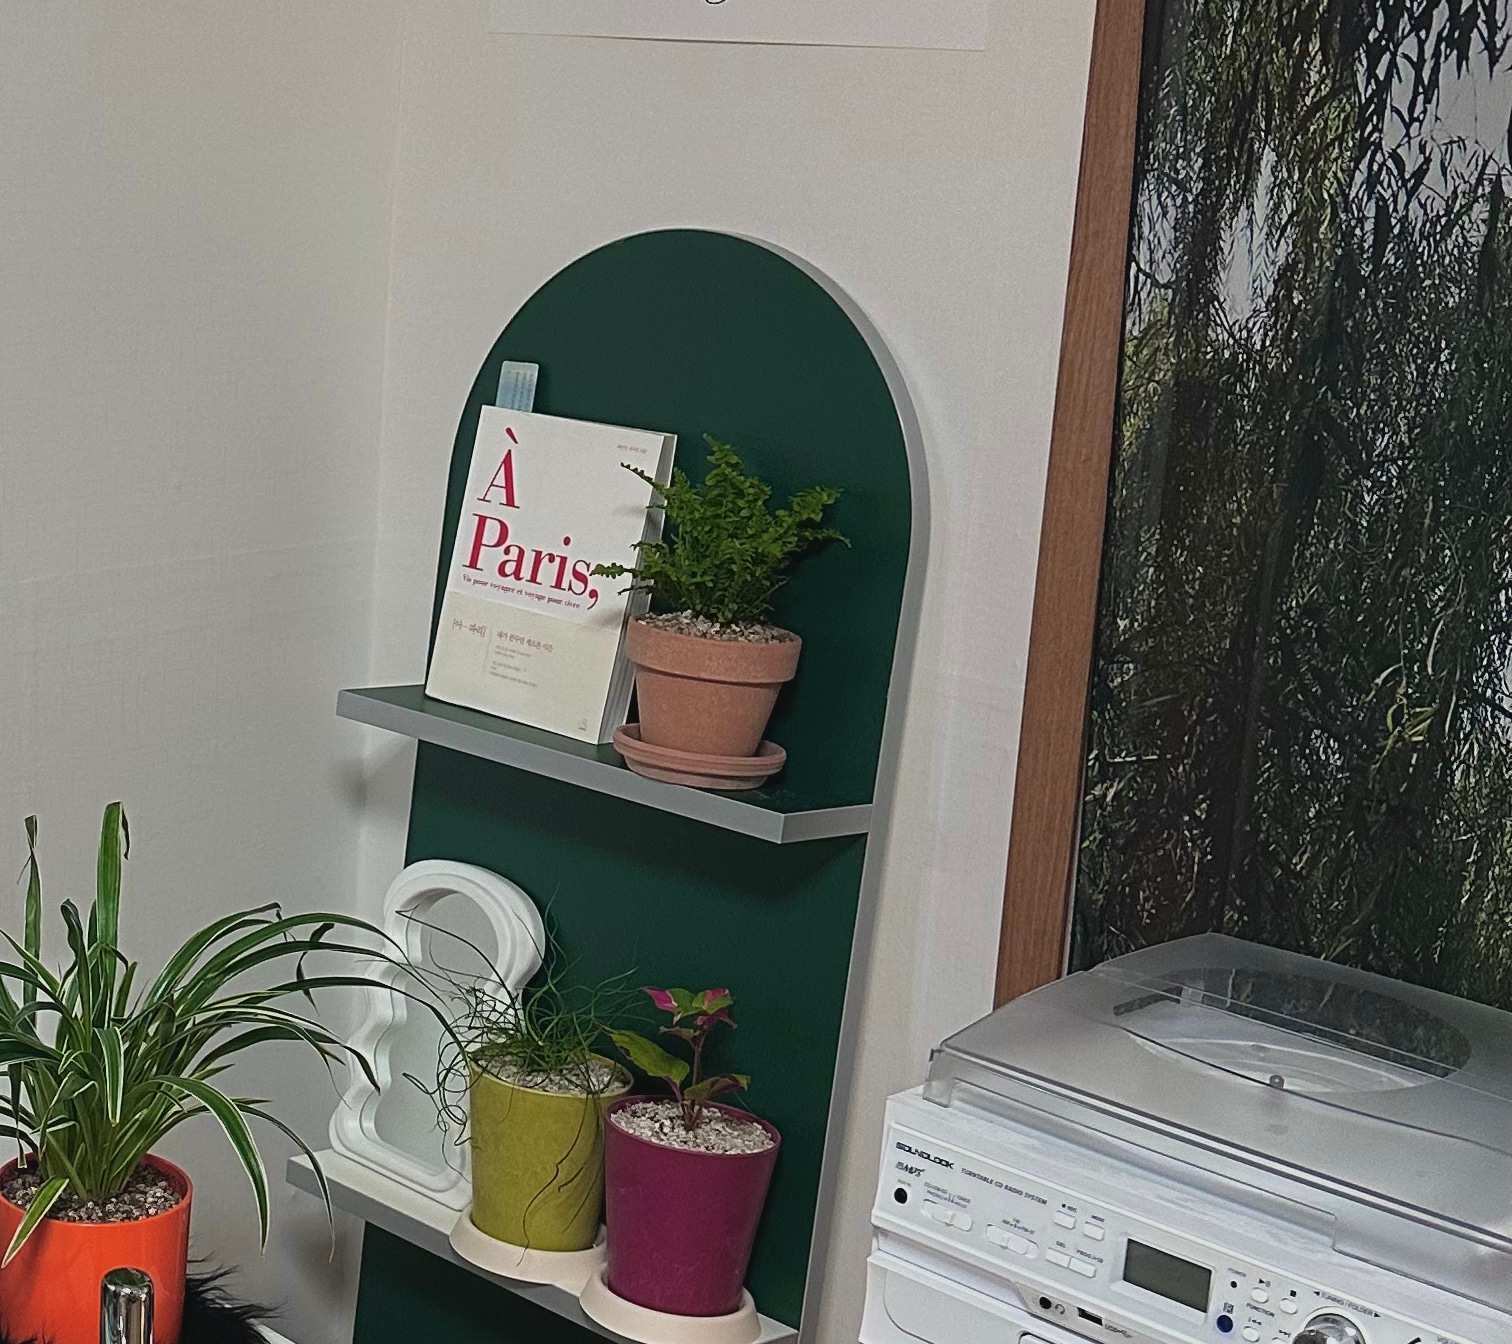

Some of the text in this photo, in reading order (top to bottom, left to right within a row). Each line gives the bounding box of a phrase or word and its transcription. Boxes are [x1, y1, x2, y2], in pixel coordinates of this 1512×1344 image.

[476, 427, 520, 510] À
[461, 513, 599, 611] Paris,
[896, 1142, 954, 1169] SOUNDLOOK
[961, 1168, 993, 1184] TURNTABLE
[1004, 1185, 1023, 1195] RADIO
[1024, 1192, 1047, 1205] SYSTEM
[1348, 1302, 1374, 1316] FOLDER
